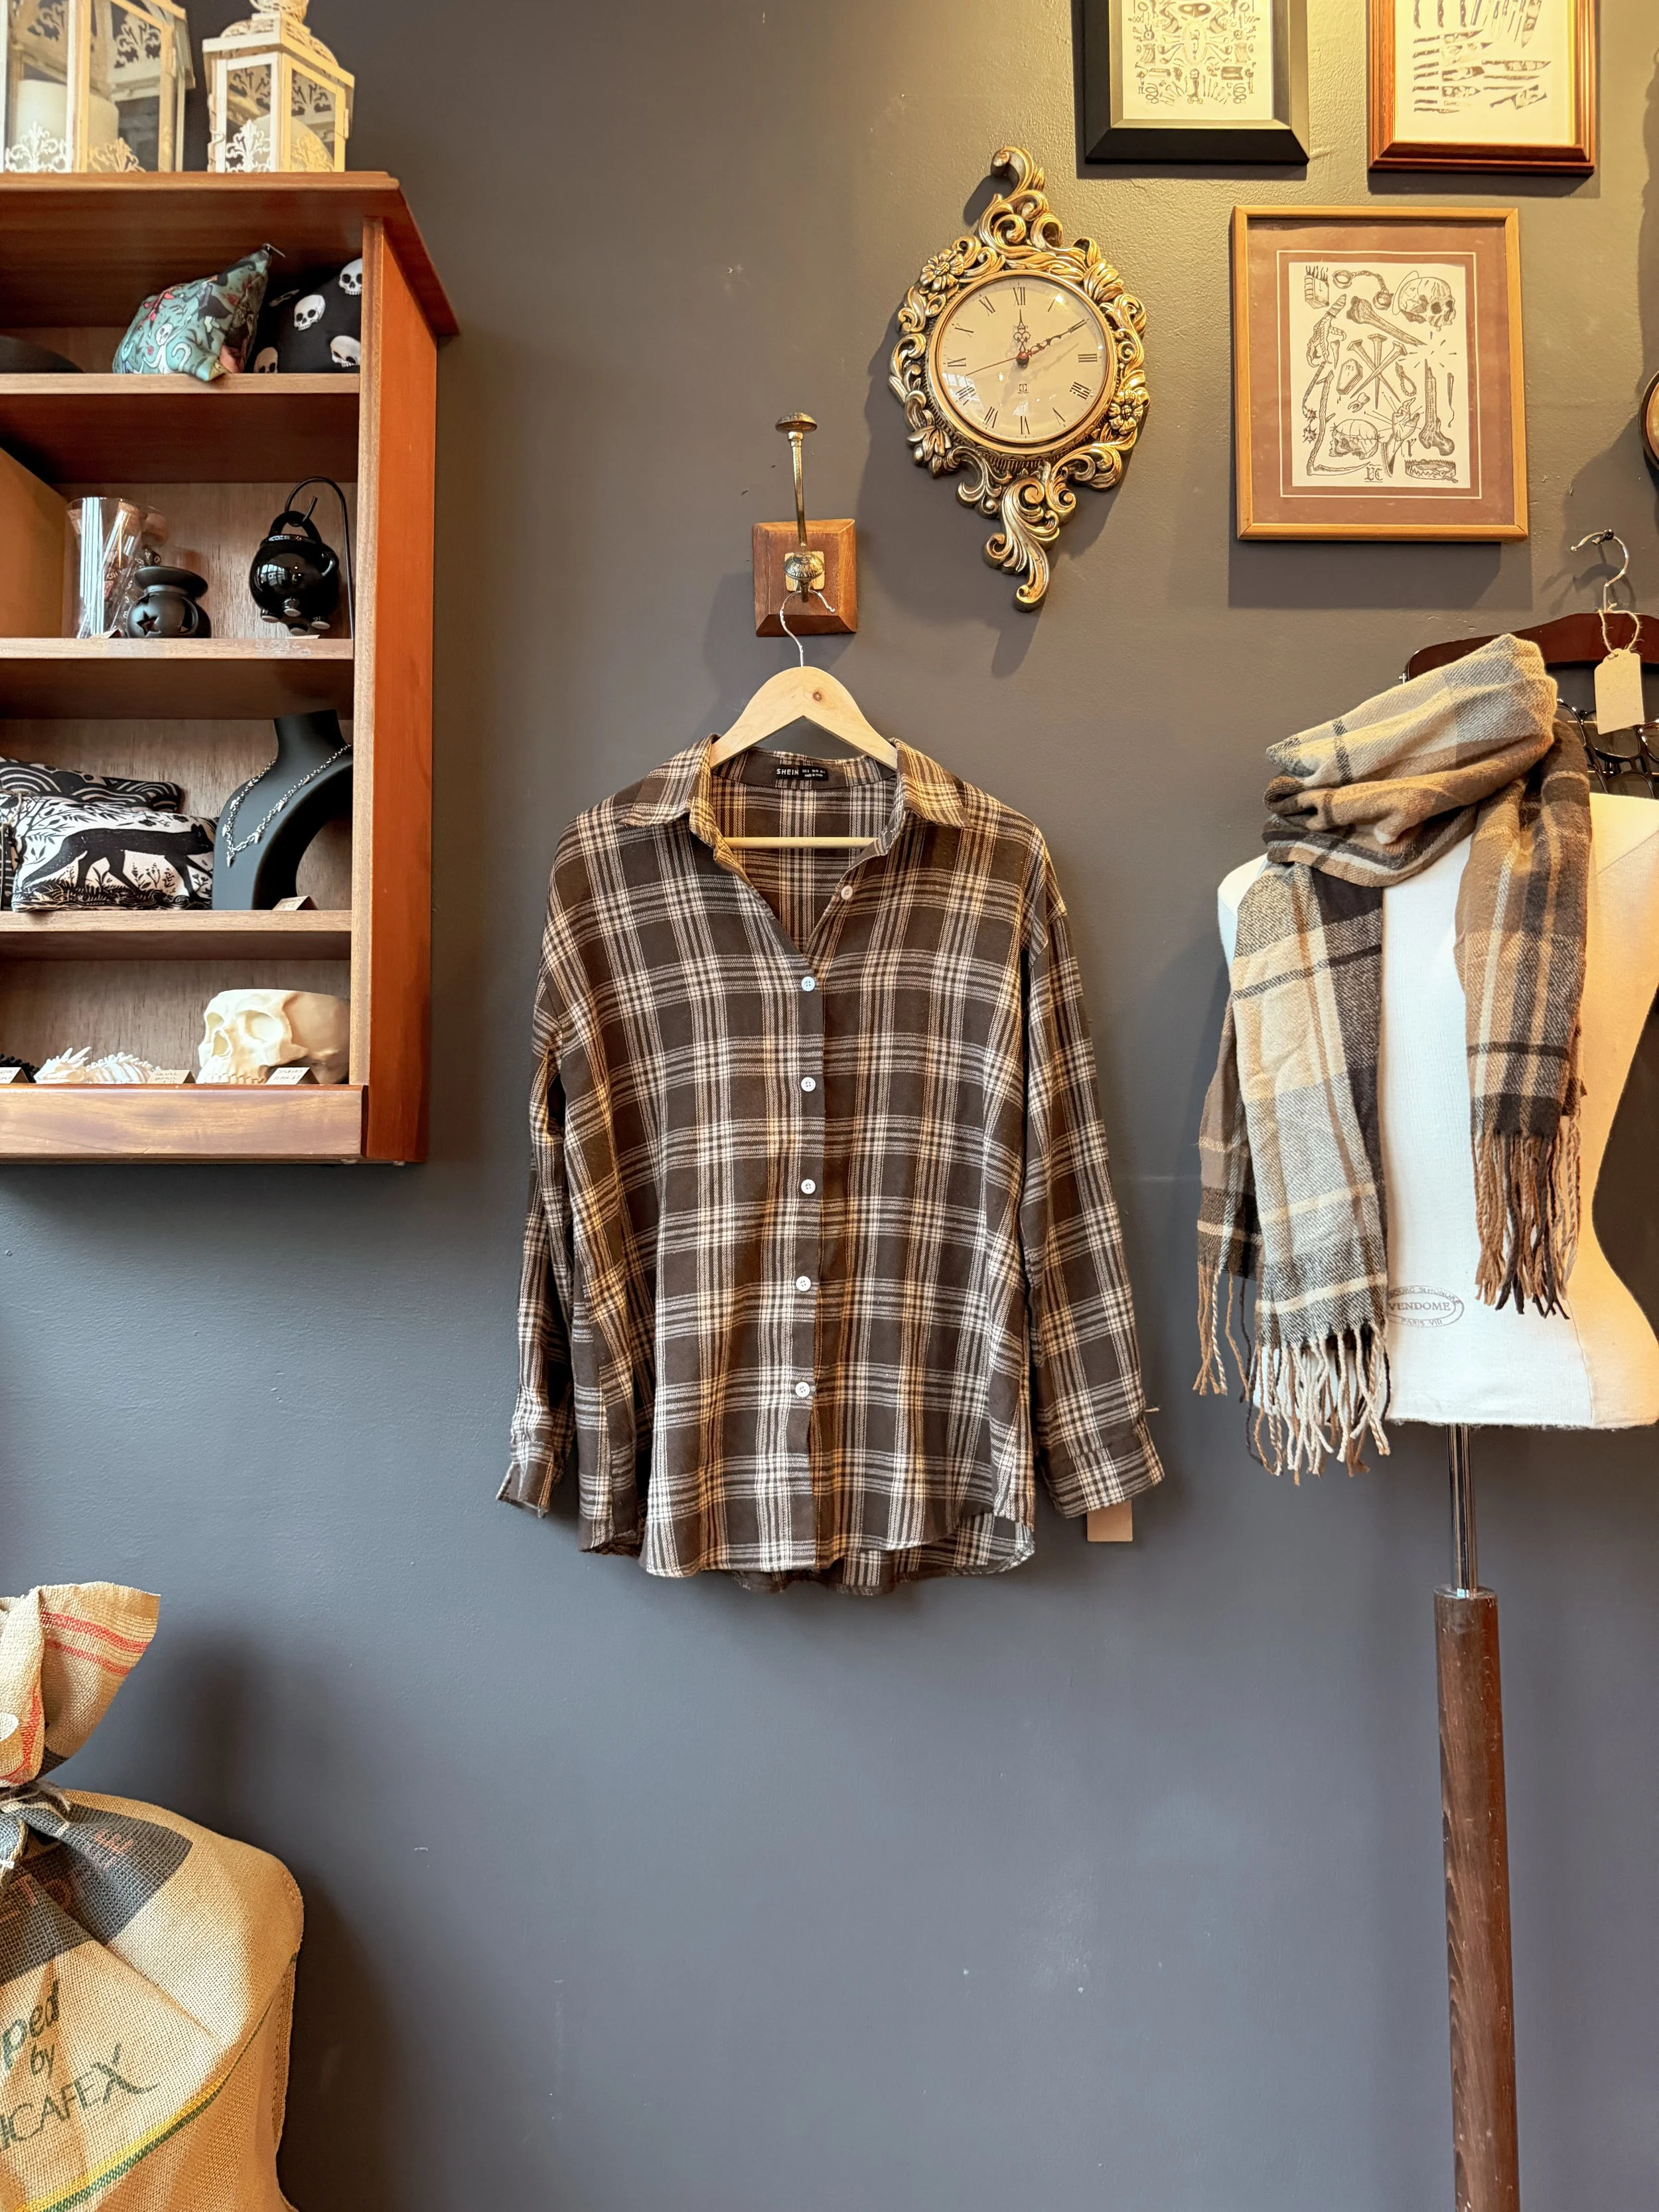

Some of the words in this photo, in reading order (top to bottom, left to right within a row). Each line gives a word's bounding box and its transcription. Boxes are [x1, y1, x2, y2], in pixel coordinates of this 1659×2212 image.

[1013, 287, 1025, 305] XII
[979, 295, 995, 316] XI
[1078, 354, 1097, 362] III
[1388, 1301, 1451, 1311] VENDOME
[31, 2043, 55, 2079] by
